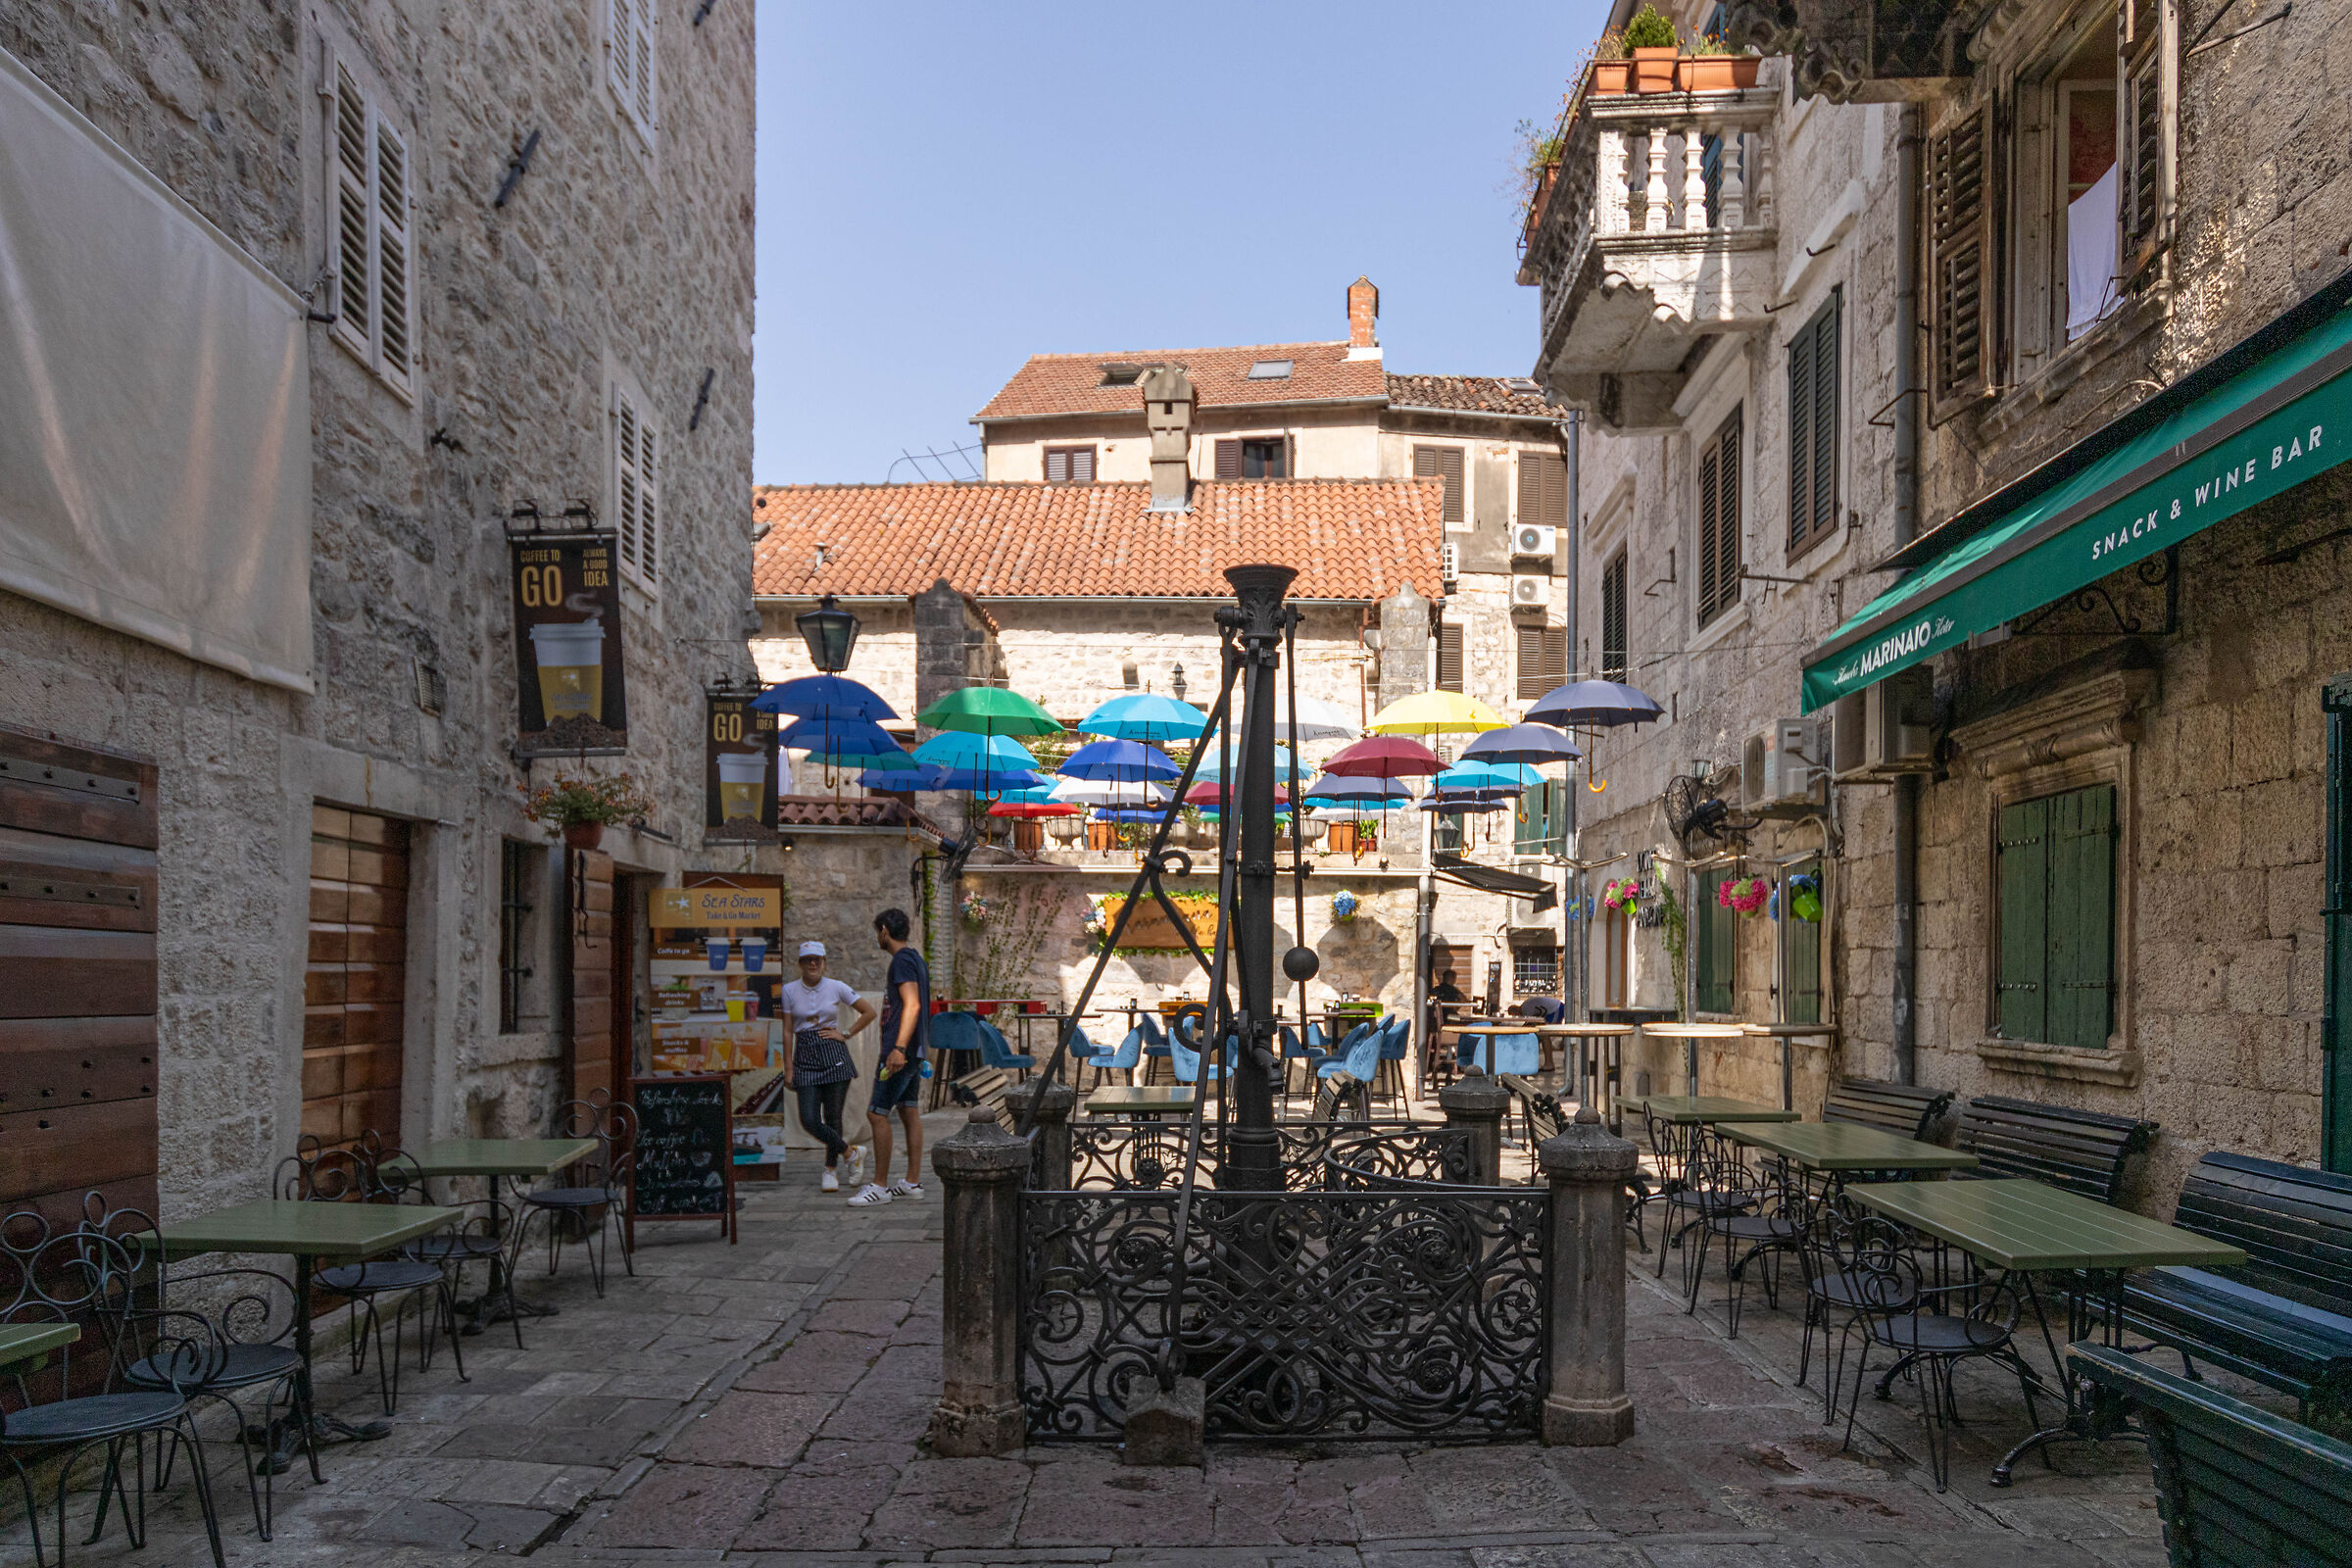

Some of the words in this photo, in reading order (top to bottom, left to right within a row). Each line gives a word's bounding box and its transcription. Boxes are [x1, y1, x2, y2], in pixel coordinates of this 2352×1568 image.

[2091, 509, 2158, 561] SNACK
[2170, 499, 2181, 520] &
[2194, 458, 2256, 508] WINE
[2270, 424, 2323, 470] BAR
[519, 549, 549, 564] COFFEE
[550, 549, 562, 563] TO
[582, 559, 589, 569] A
[589, 558, 608, 568] GOOD
[520, 564, 563, 608] GO
[583, 570, 609, 587] IDEA
[1860, 620, 1932, 678] MARINAIO
[713, 712, 742, 742] GO
[756, 718, 774, 730] IDEA
[702, 893, 727, 909] SEA
[730, 894, 766, 909] STARS
[707, 910, 721, 919] Take
